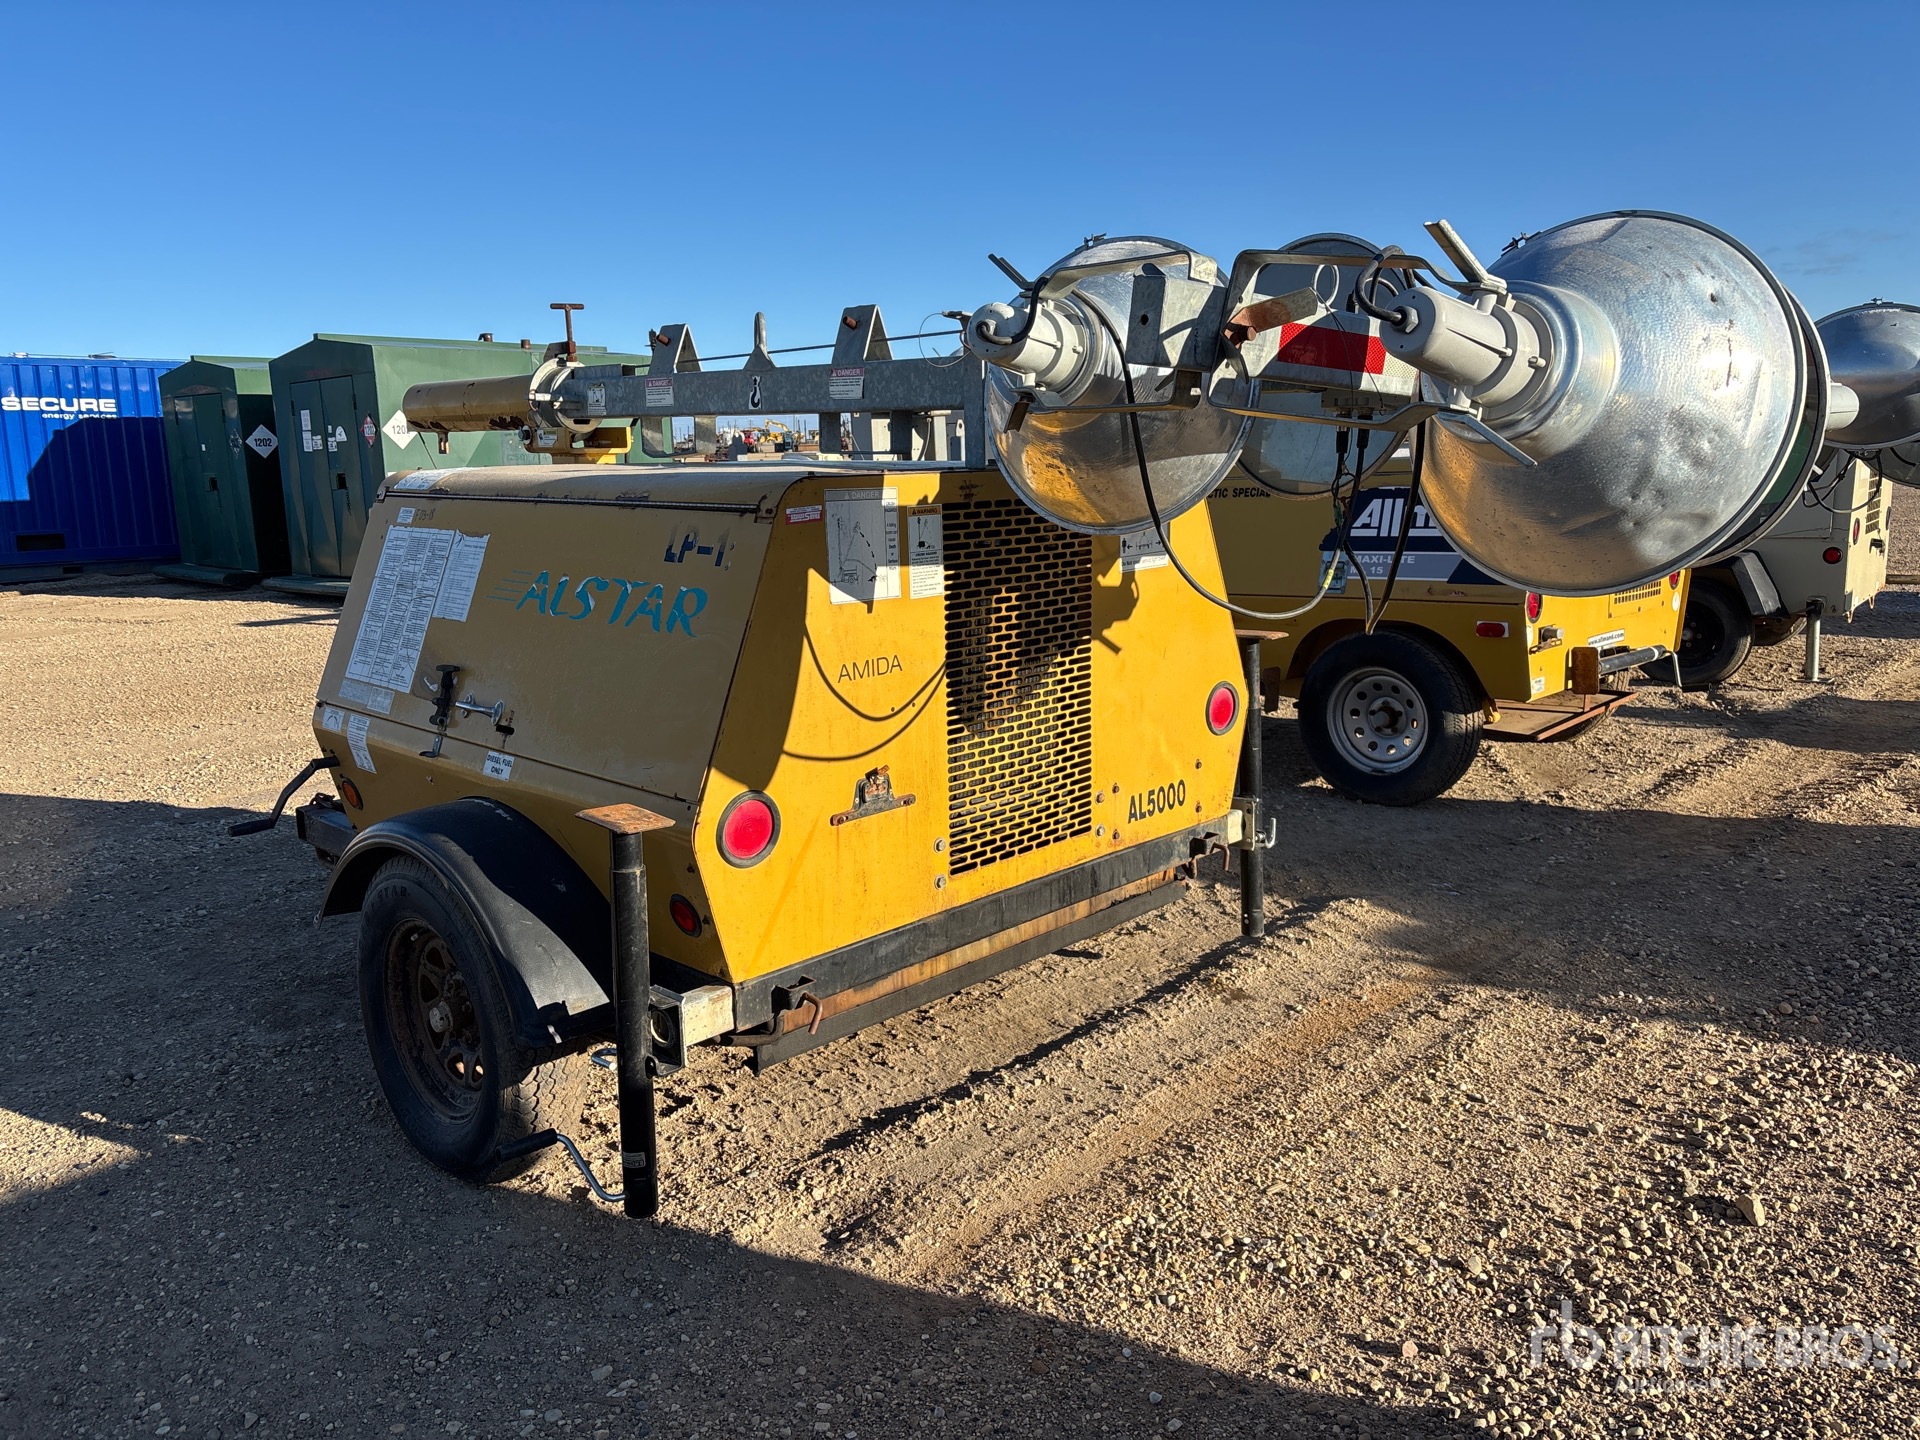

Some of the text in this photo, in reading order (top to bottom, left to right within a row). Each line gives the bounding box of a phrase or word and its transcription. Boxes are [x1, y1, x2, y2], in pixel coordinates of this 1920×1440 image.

[1, 396, 117, 412] SECURE
[254, 438, 273, 447] 1202
[1232, 487, 1271, 498] SPECIAL
[1356, 555, 1416, 564] MAXI-LTE
[1370, 566, 1383, 574] 15
[516, 570, 708, 637] ALSTAR
[837, 655, 902, 683] AMIDA
[487, 754, 512, 767] DIESEL FUEL
[491, 766, 503, 775] ONLY
[1127, 779, 1187, 822] AL5000
